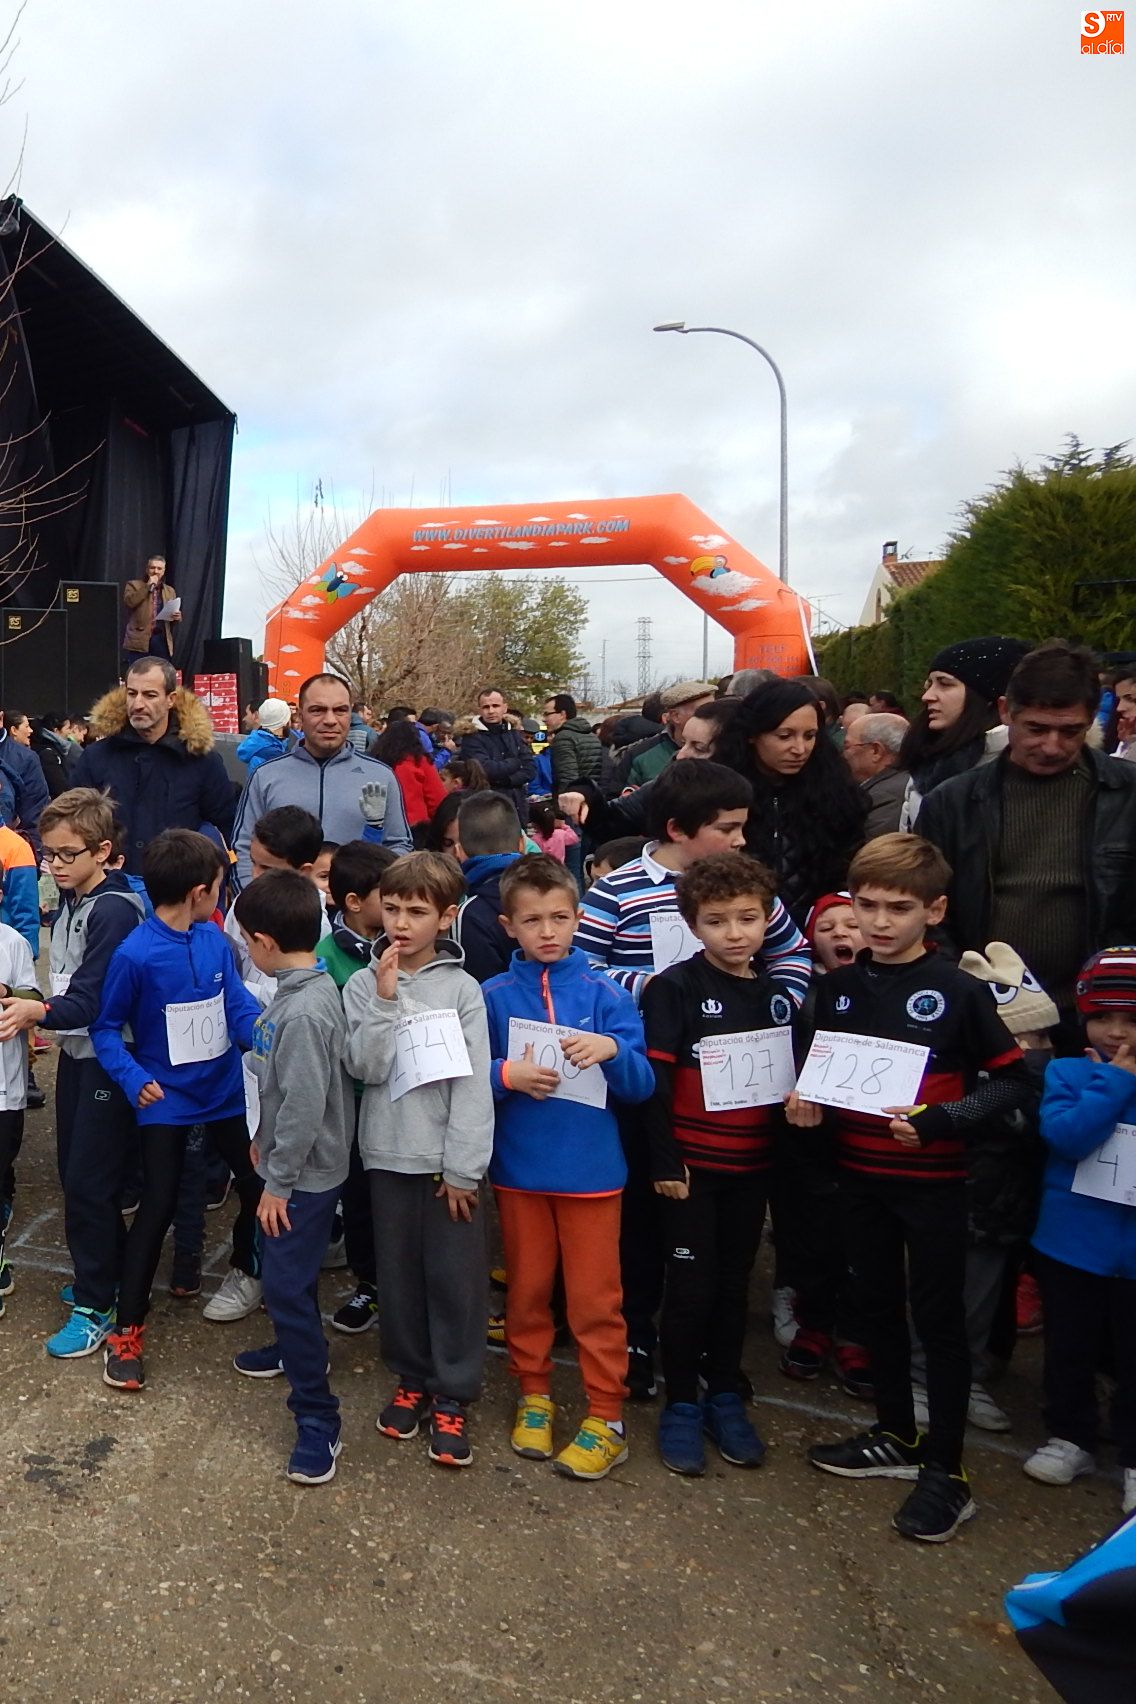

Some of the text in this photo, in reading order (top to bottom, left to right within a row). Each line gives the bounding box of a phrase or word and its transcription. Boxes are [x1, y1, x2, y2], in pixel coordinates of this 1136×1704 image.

[182, 1009, 225, 1047] 105
[413, 1011, 456, 1024] Salamanca
[510, 1018, 554, 1035] Diputación
[555, 1027, 566, 1037] de
[700, 1037, 744, 1048] Diputación
[755, 1029, 791, 1042] Salamanca
[815, 1032, 861, 1045] Diputación
[876, 1039, 927, 1057] Salamanca
[719, 1048, 775, 1091] 127
[817, 1050, 894, 1095] 128
